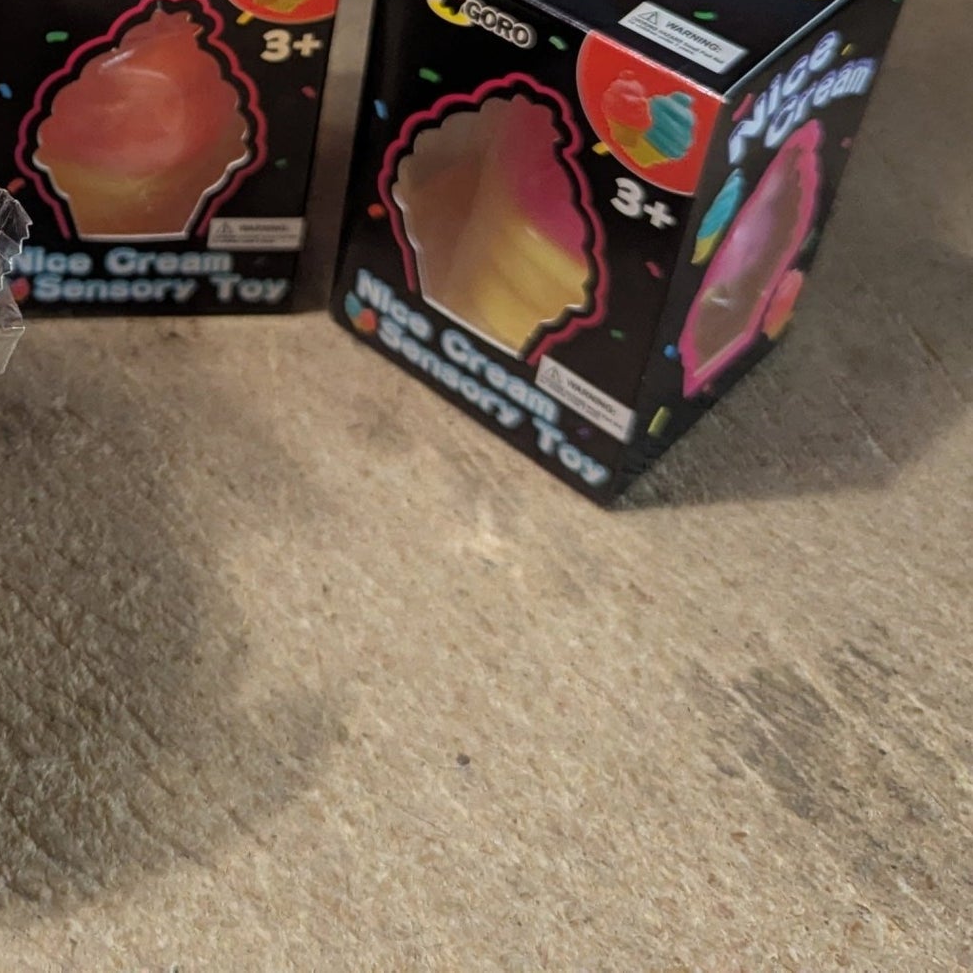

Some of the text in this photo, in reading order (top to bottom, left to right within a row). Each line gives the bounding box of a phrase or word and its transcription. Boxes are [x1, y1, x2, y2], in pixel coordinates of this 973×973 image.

[260, 29, 320, 62] 3+
[464, 0, 537, 49] GORO
[666, 20, 723, 53] WARNING:
[729, 30, 841, 165] Nice
[764, 57, 875, 148] Cream
[610, 177, 676, 229] 3+
[104, 246, 234, 276] Cream
[33, 273, 290, 302] Sensory Toy
[356, 268, 433, 342] Nice
[441, 329, 561, 424] Cream
[378, 315, 523, 428] Sensory
[532, 416, 610, 487] Toy
